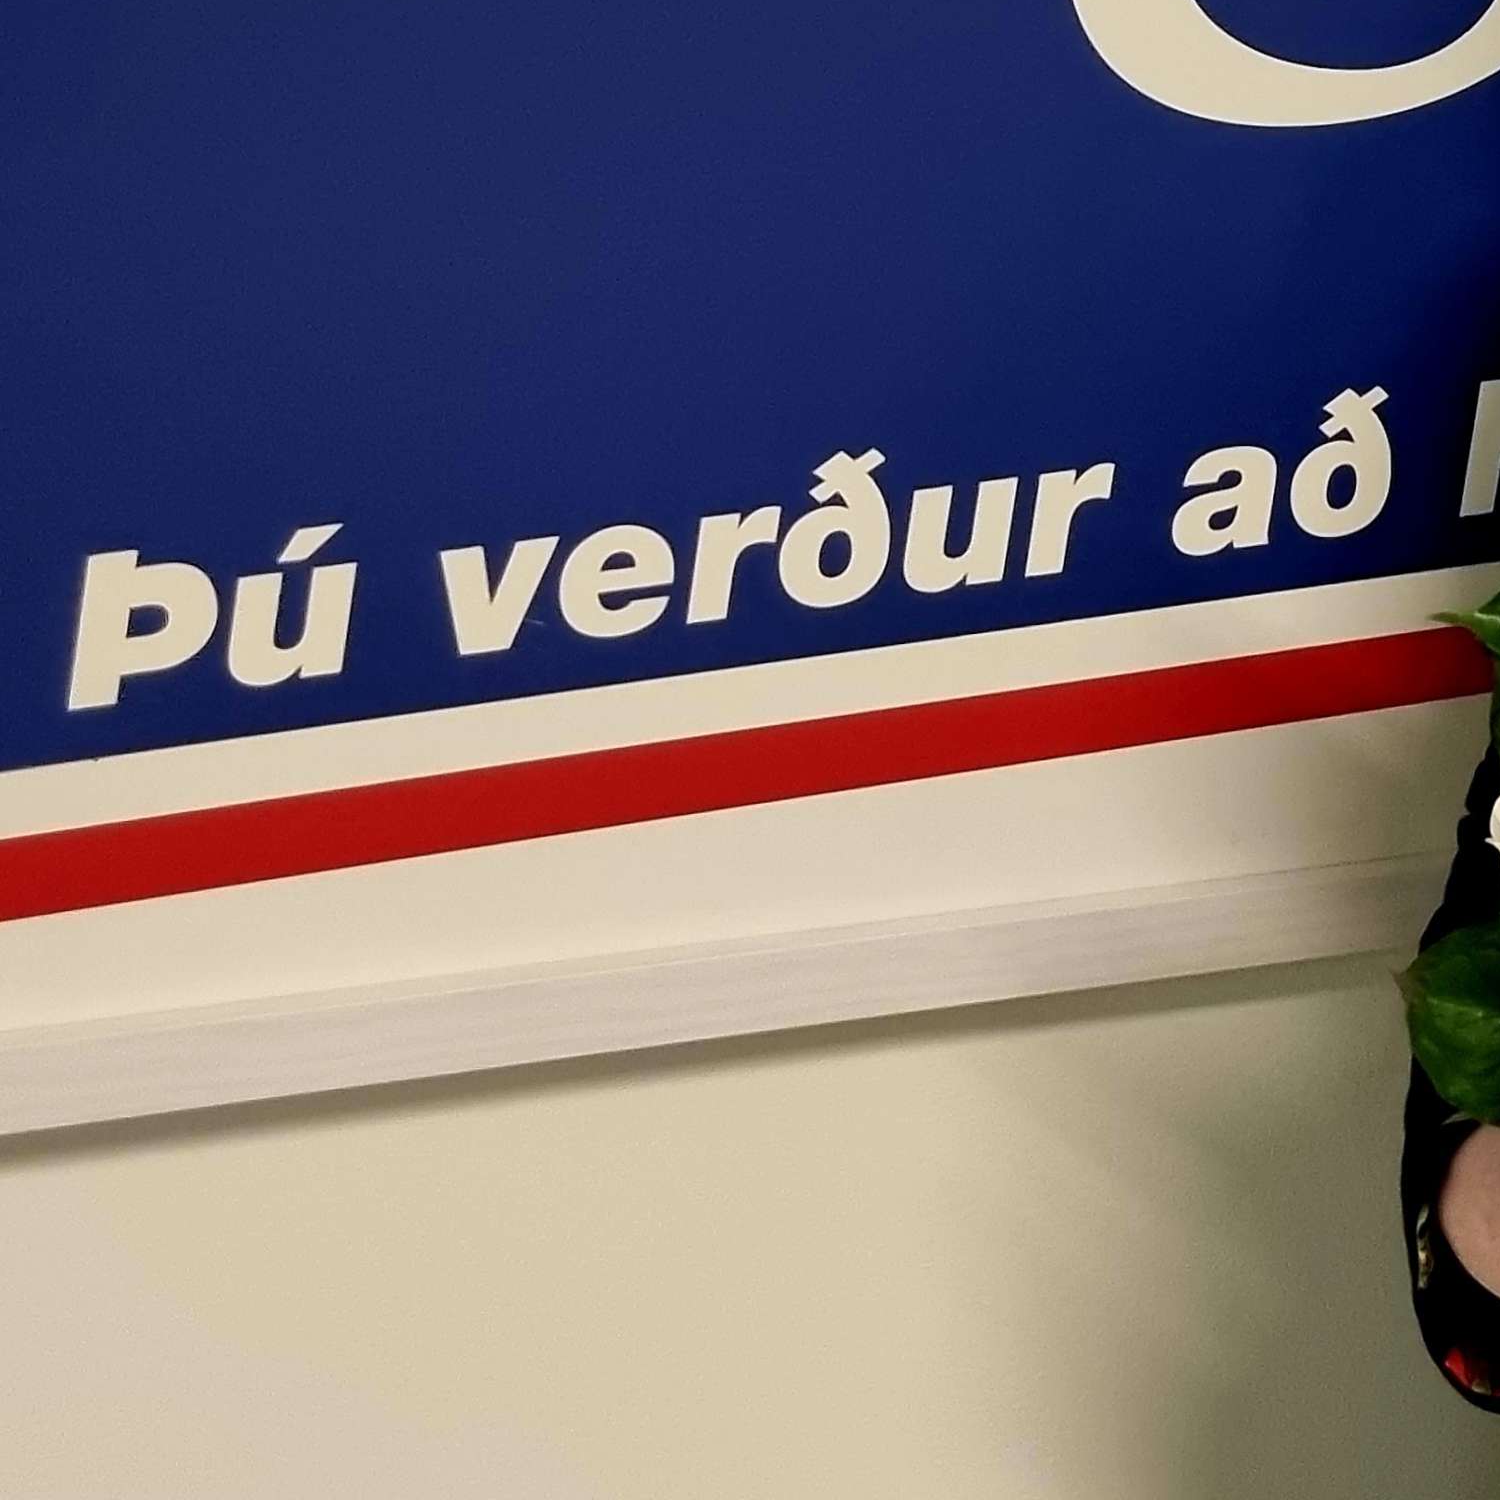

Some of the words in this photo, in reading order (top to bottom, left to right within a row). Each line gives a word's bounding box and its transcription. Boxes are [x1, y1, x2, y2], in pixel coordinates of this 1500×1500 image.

[67, 523, 358, 712] Þú
[440, 447, 1116, 656] verður
[1170, 386, 1392, 556] að
